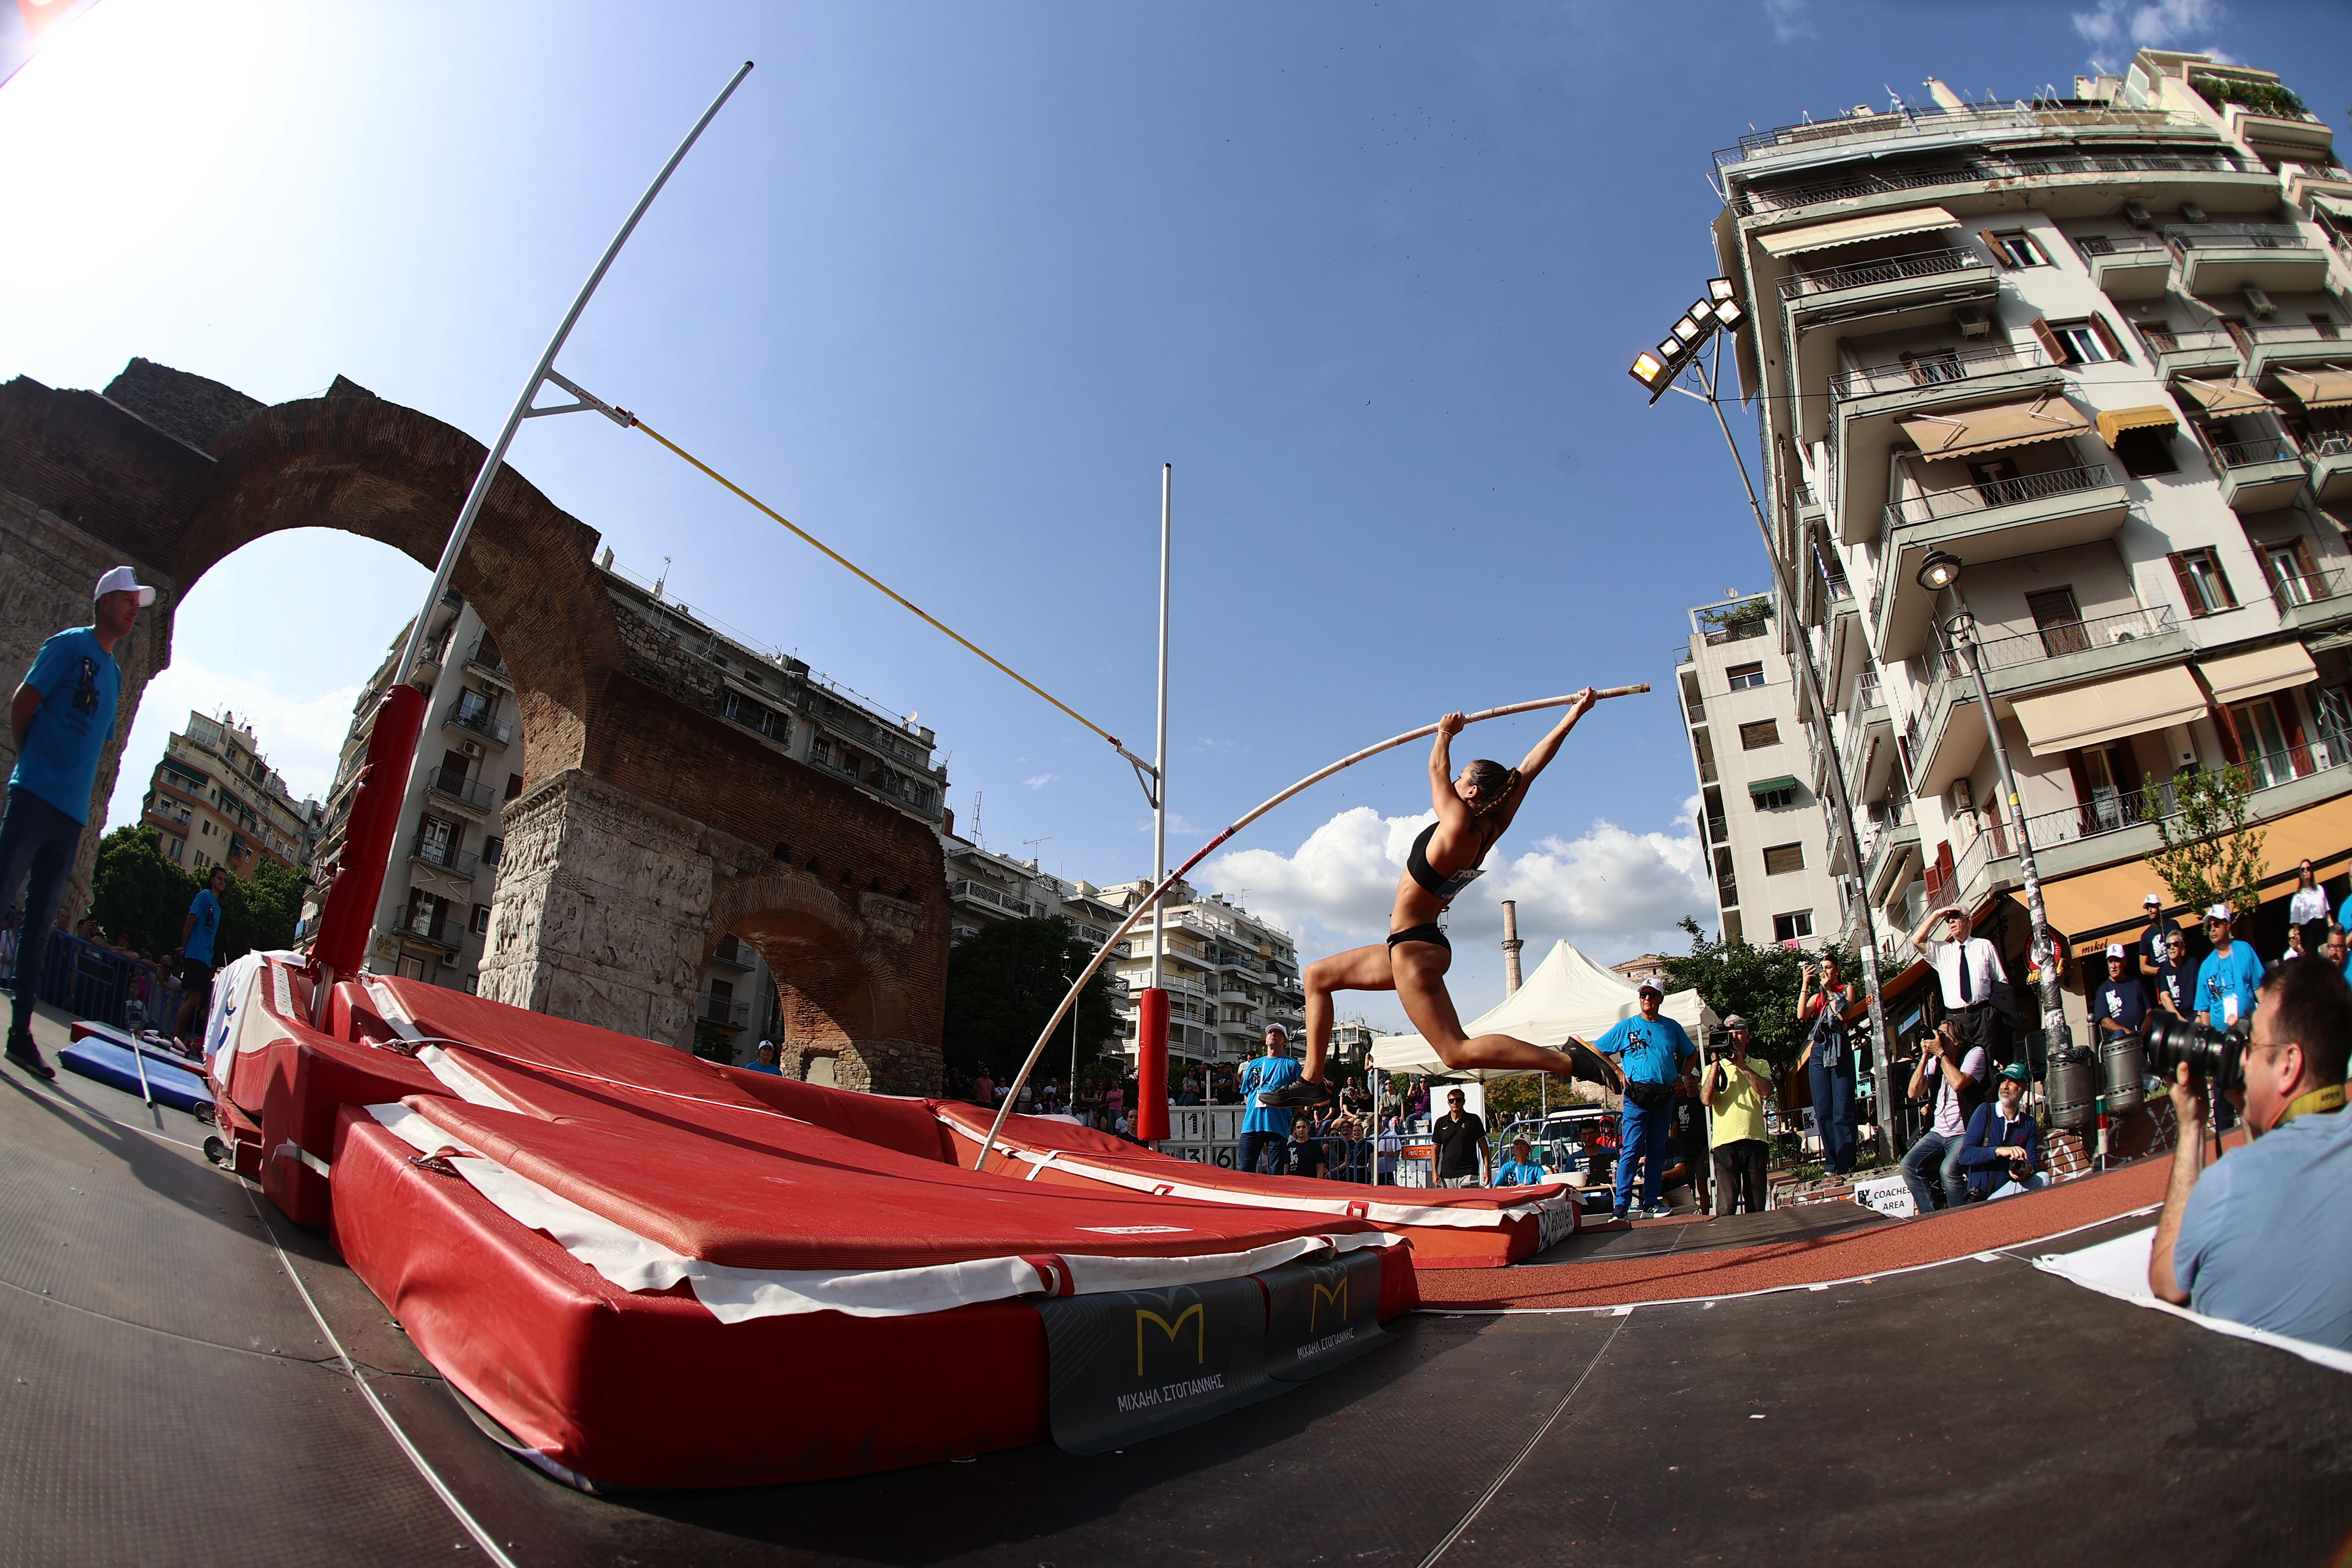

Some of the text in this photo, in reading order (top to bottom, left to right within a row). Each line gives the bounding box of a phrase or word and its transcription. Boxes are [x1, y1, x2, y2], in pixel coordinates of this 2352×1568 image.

[2082, 938, 2108, 955] mikel
[1188, 1113, 1197, 1134] 1
[1217, 1147, 1231, 1169] 6
[1874, 1186, 1911, 1199] COACHES
[1883, 1200, 1905, 1211] AREA
[1297, 1327, 1354, 1360] ΜΙΧΑΗΛ ΣΤΟΓΙΑΝΝΗΣ
[1117, 1373, 1225, 1412] ΜΙΧΑΗΛ ΣΤΟΓΙΑΝΝΗΣ
